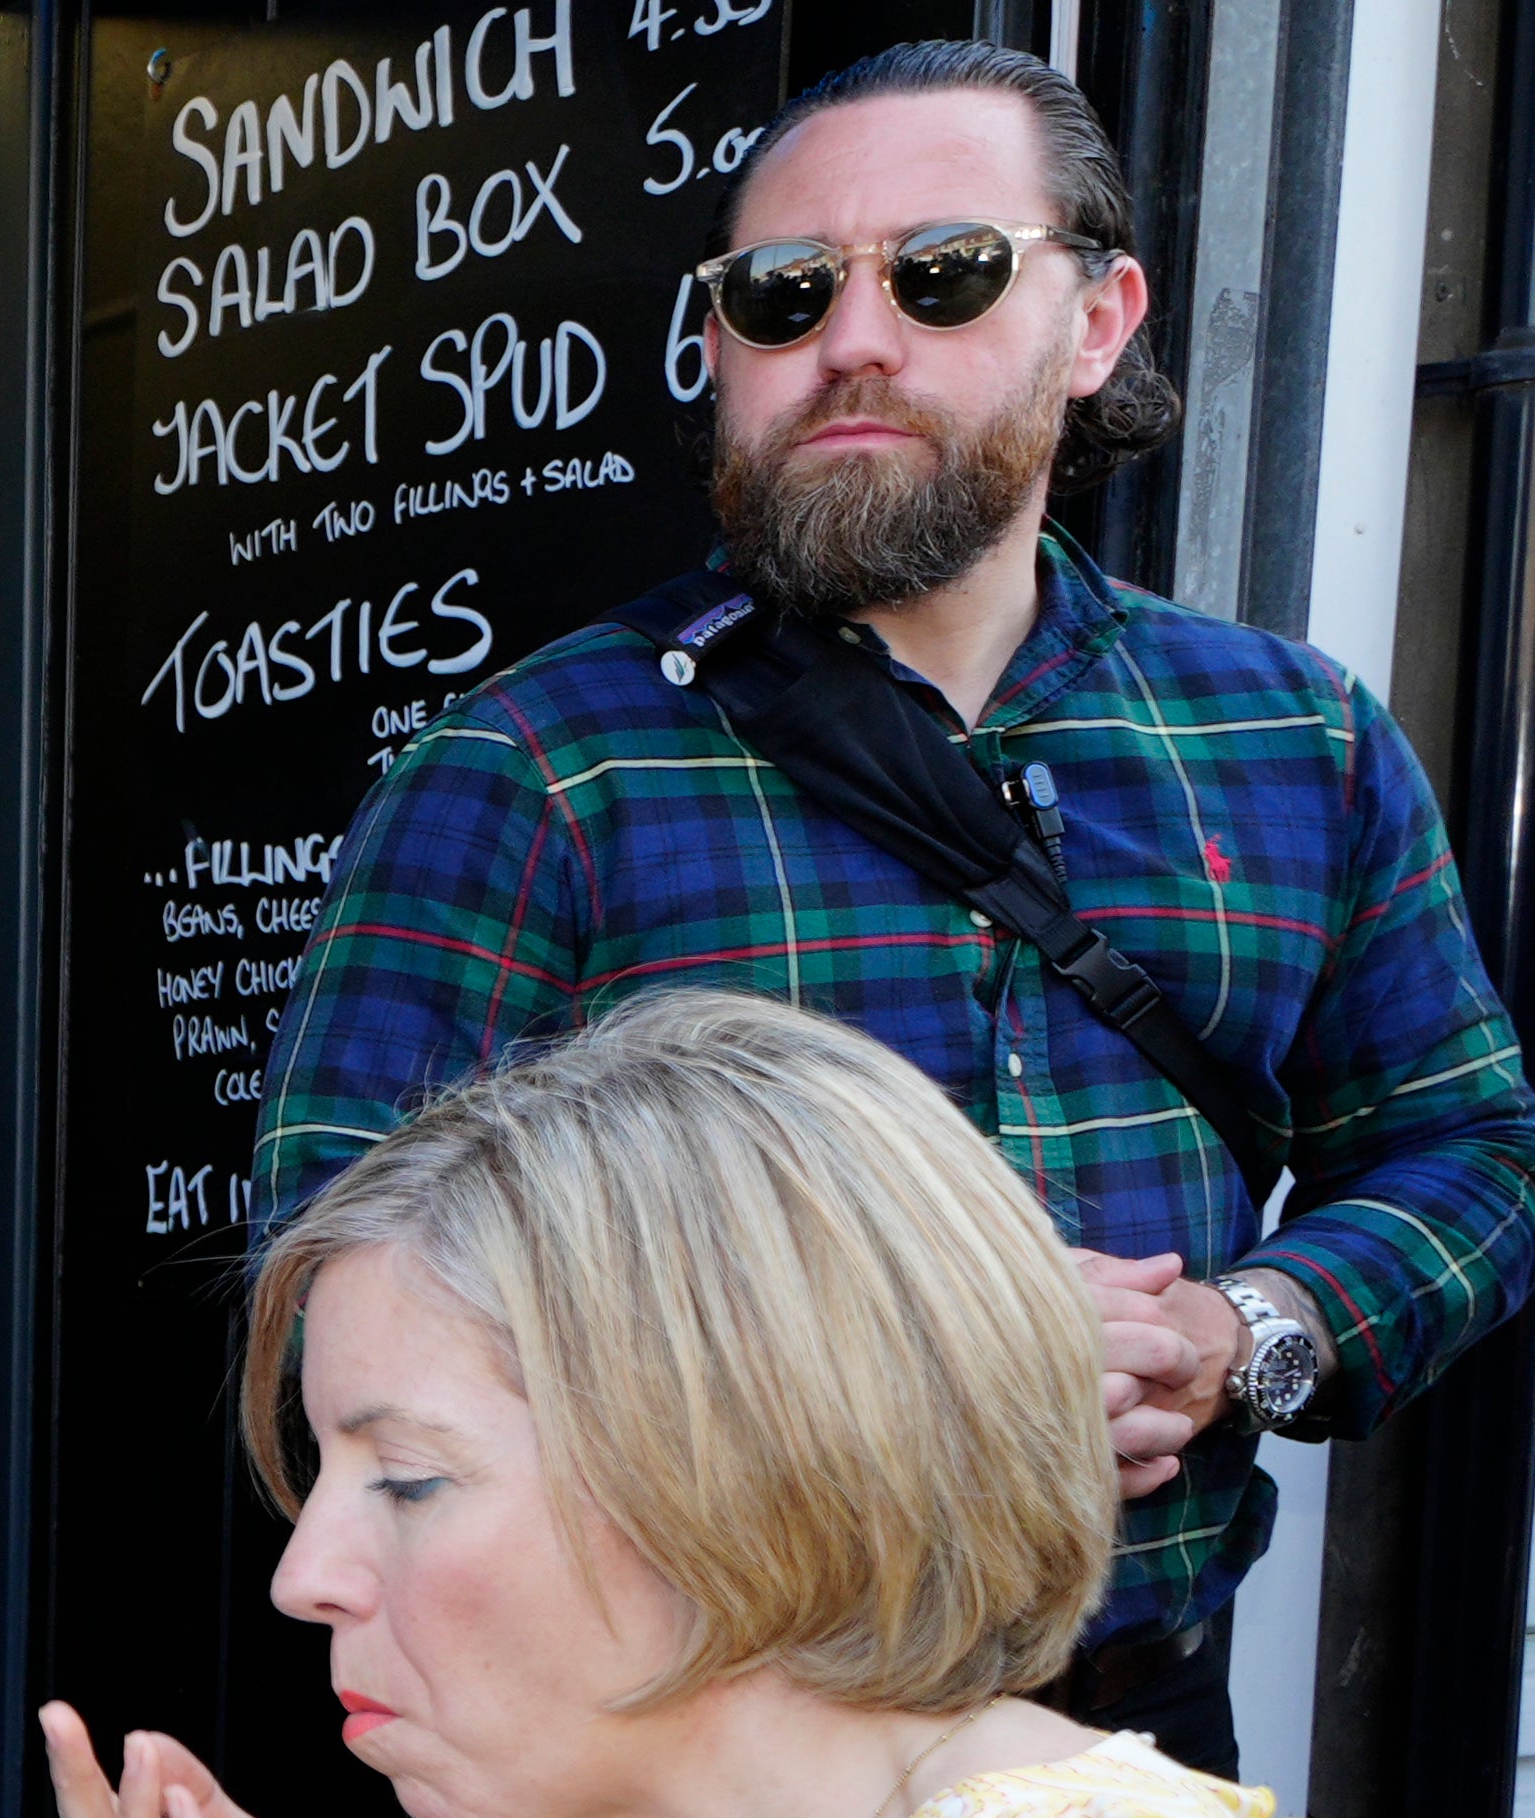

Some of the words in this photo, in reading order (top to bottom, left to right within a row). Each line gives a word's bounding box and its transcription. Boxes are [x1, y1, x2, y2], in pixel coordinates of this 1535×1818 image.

[164, 0, 577, 238] SANDWICH
[156, 215, 375, 359] SALAD
[414, 143, 583, 282] BOX
[642, 81, 767, 196] 5.0
[152, 344, 393, 498] JACKET
[421, 311, 608, 457] SPUD
[229, 518, 298, 567] WITH
[311, 498, 375, 543] TWO
[393, 467, 512, 526] FILLINGS
[520, 474, 537, 502] +
[542, 450, 636, 493] SALAD
[141, 567, 494, 733] TOASTIES
[371, 699, 428, 739] ONE
[162, 898, 245, 943] BEANS,
[157, 960, 225, 1009] HONEY
[172, 1013, 257, 1062] PRAWN,
[145, 1159, 214, 1235] EAT
